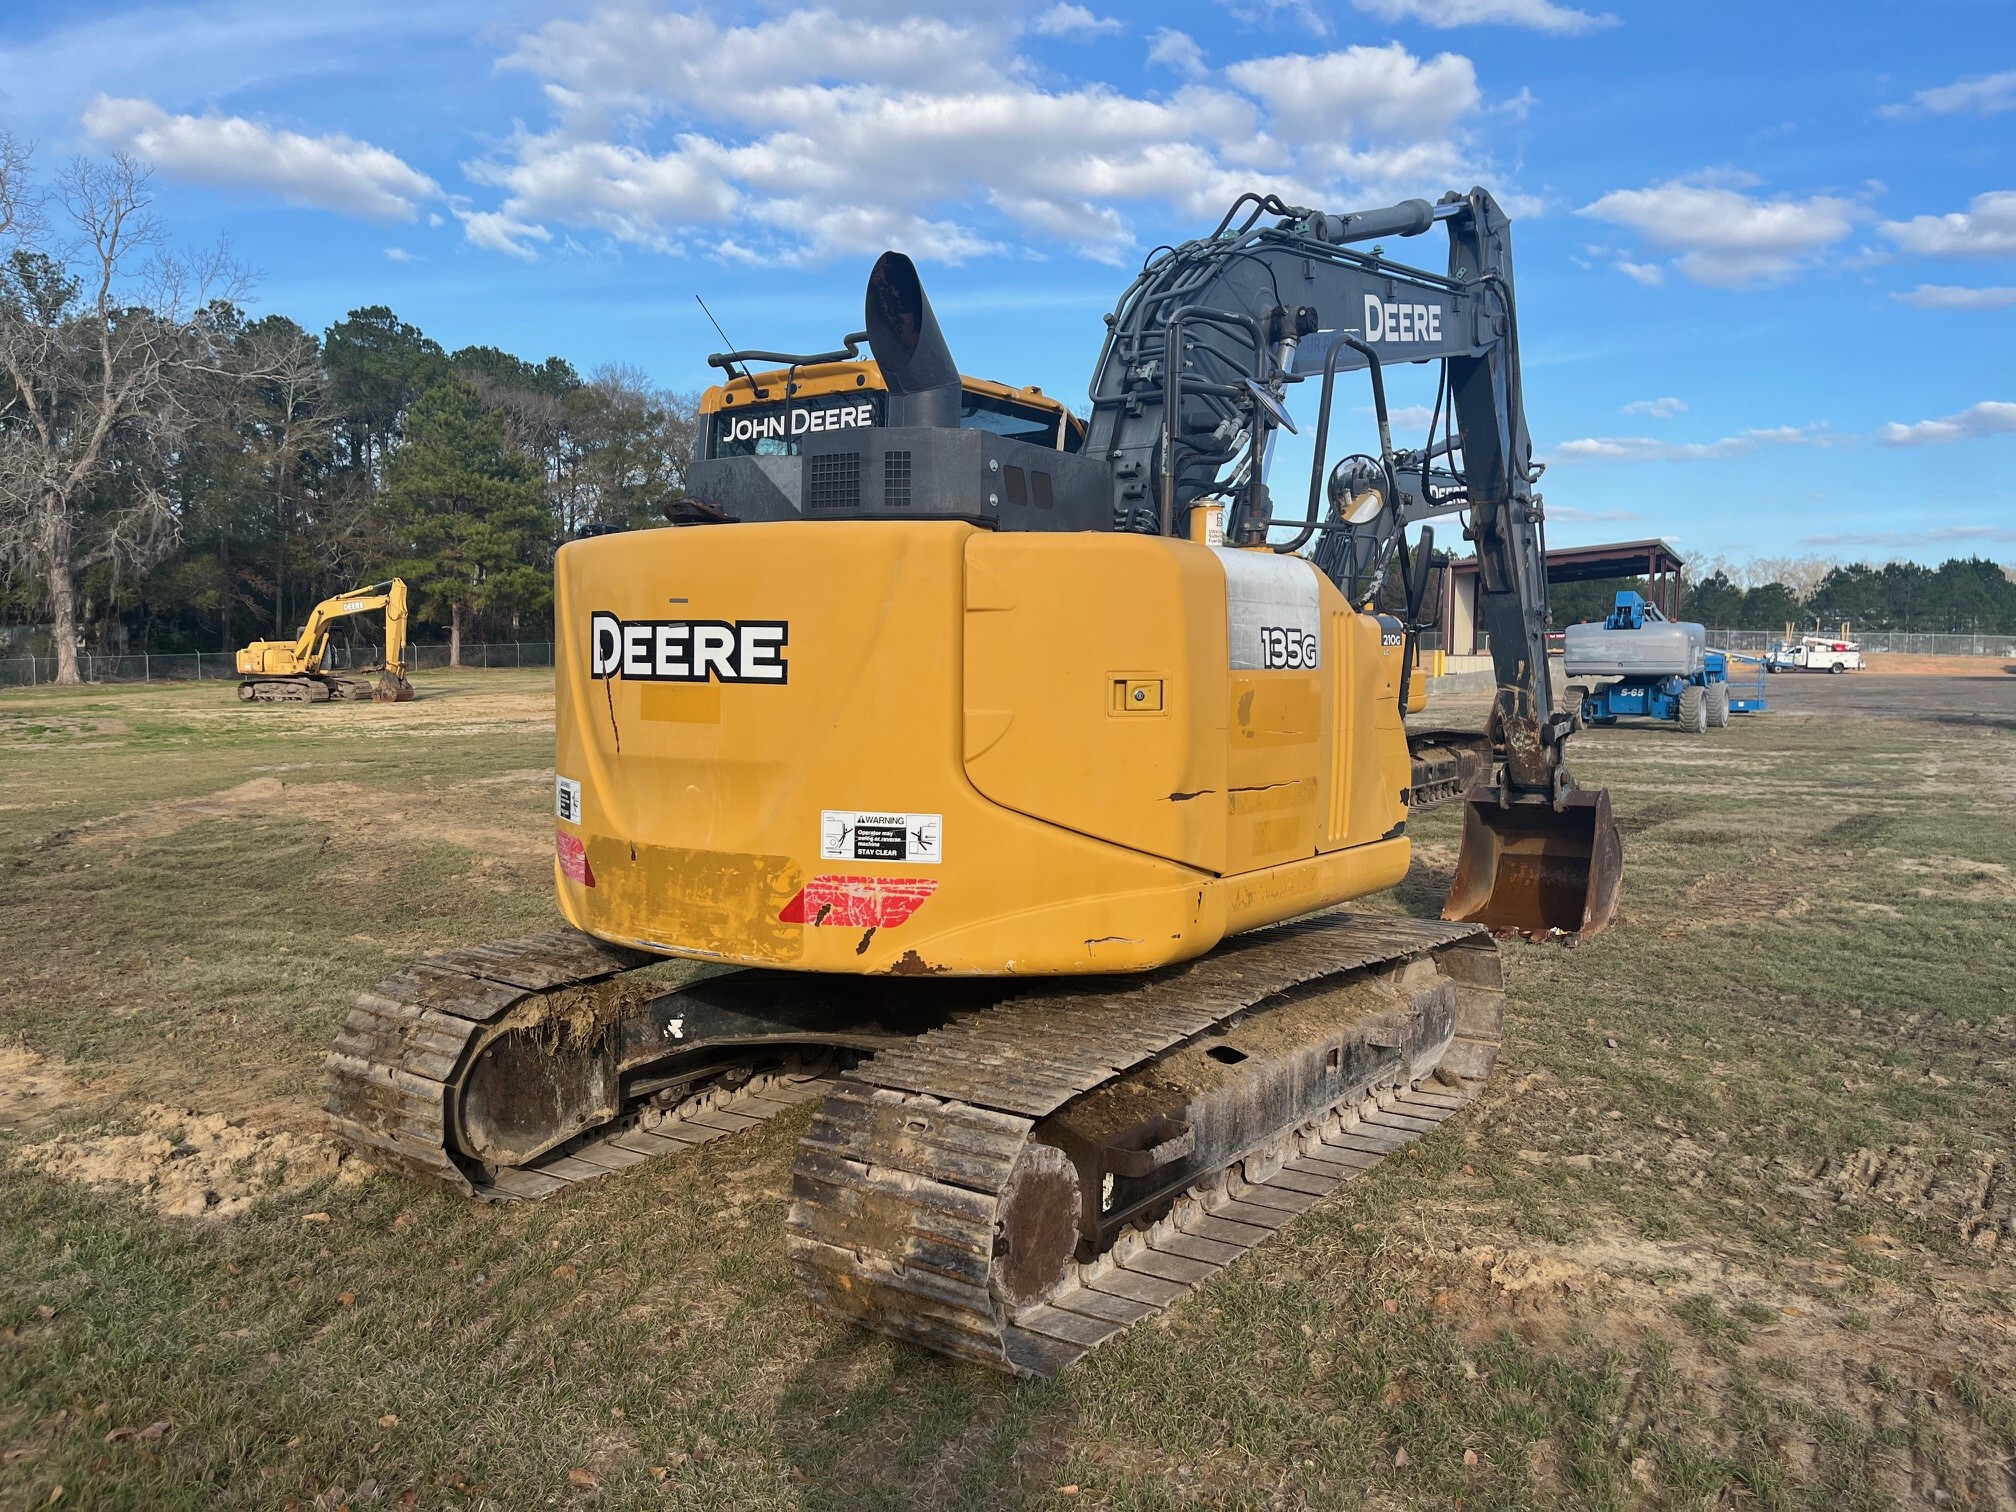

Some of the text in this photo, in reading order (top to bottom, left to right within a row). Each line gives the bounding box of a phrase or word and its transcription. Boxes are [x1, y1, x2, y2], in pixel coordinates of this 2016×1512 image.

[1364, 294, 1443, 342] DEERE
[723, 404, 873, 442] JOHN DEERE
[343, 601, 364, 611] DEERE
[591, 611, 788, 684] DEERE
[1261, 627, 1316, 669] 135G
[1383, 634, 1401, 646] 210G
[1620, 688, 1644, 697] S-65
[866, 816, 904, 825] WARNING
